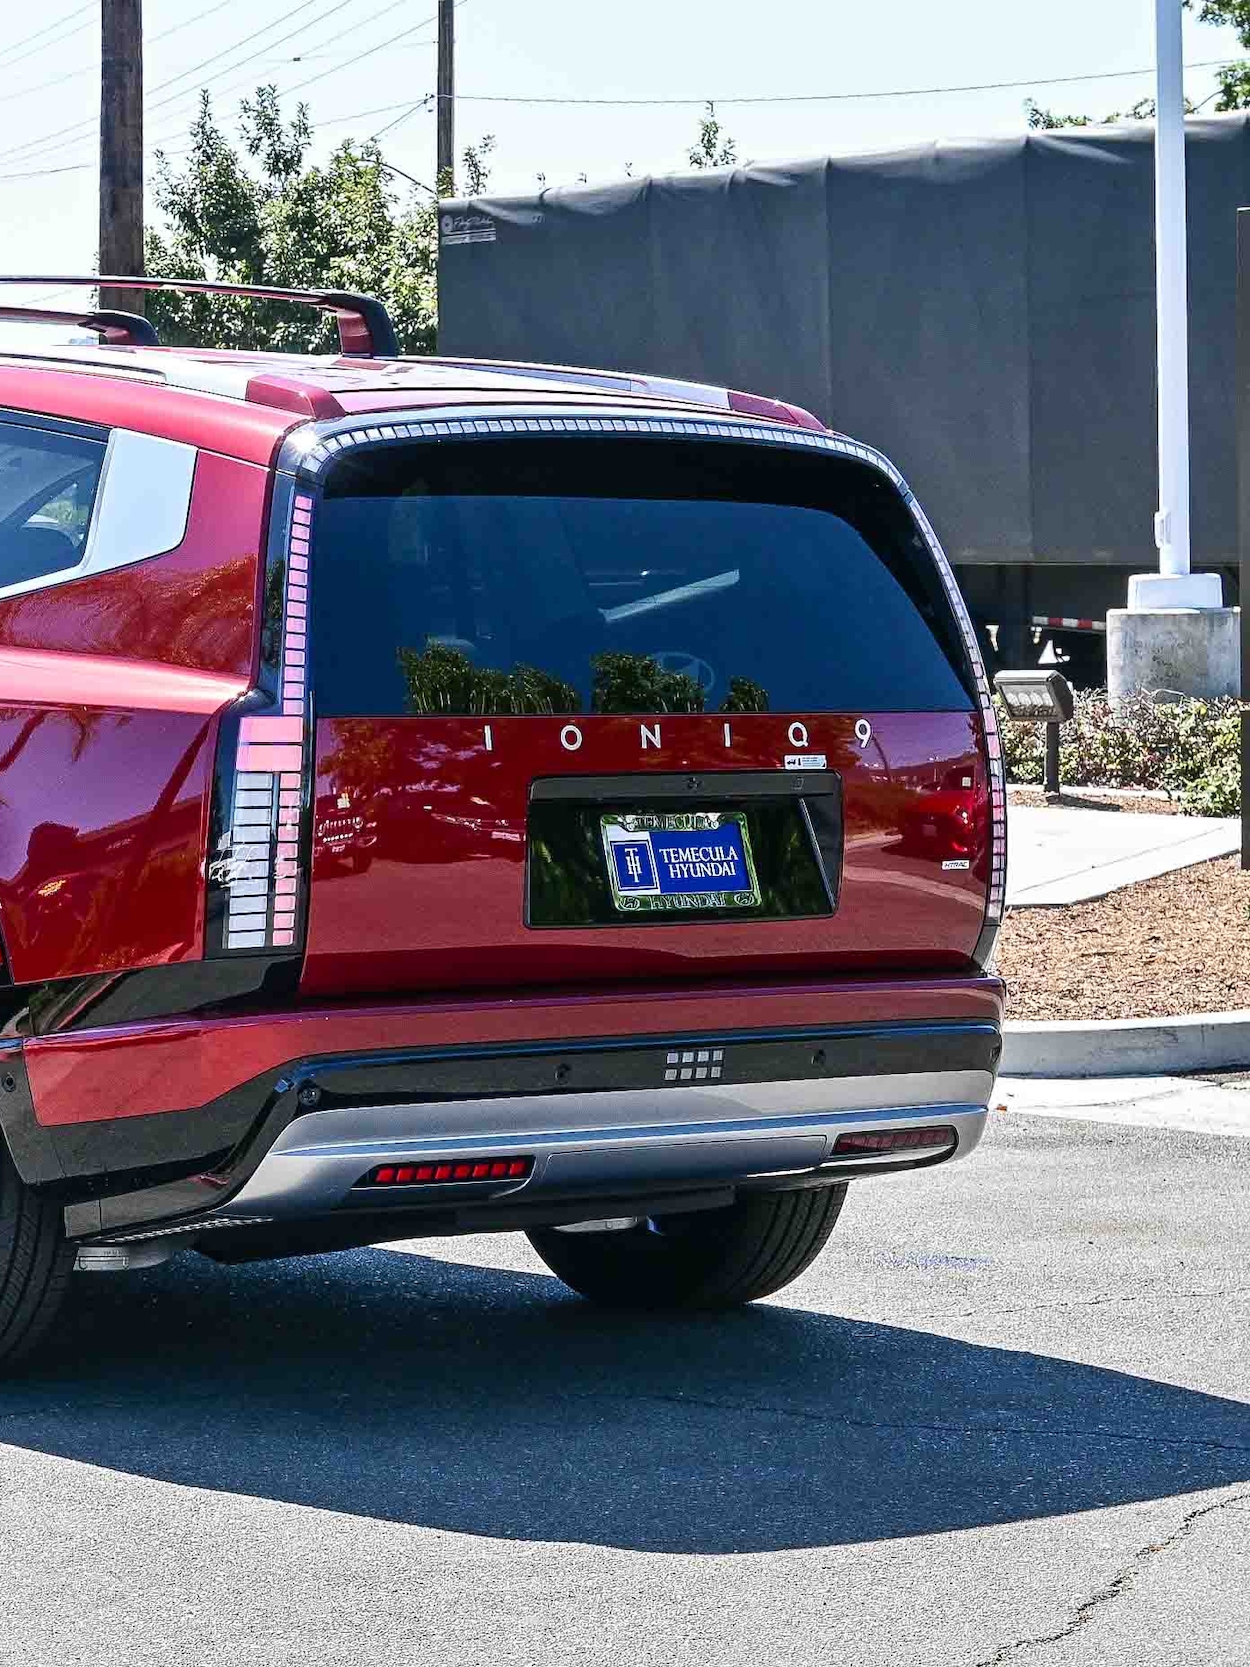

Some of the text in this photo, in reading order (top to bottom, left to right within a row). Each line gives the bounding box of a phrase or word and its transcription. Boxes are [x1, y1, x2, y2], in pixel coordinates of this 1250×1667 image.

[483, 718, 873, 751] IONIQ 9
[658, 846, 739, 863] TEMECULA
[668, 861, 737, 879] HYUNDAI
[650, 893, 726, 910] HYUNDAI
